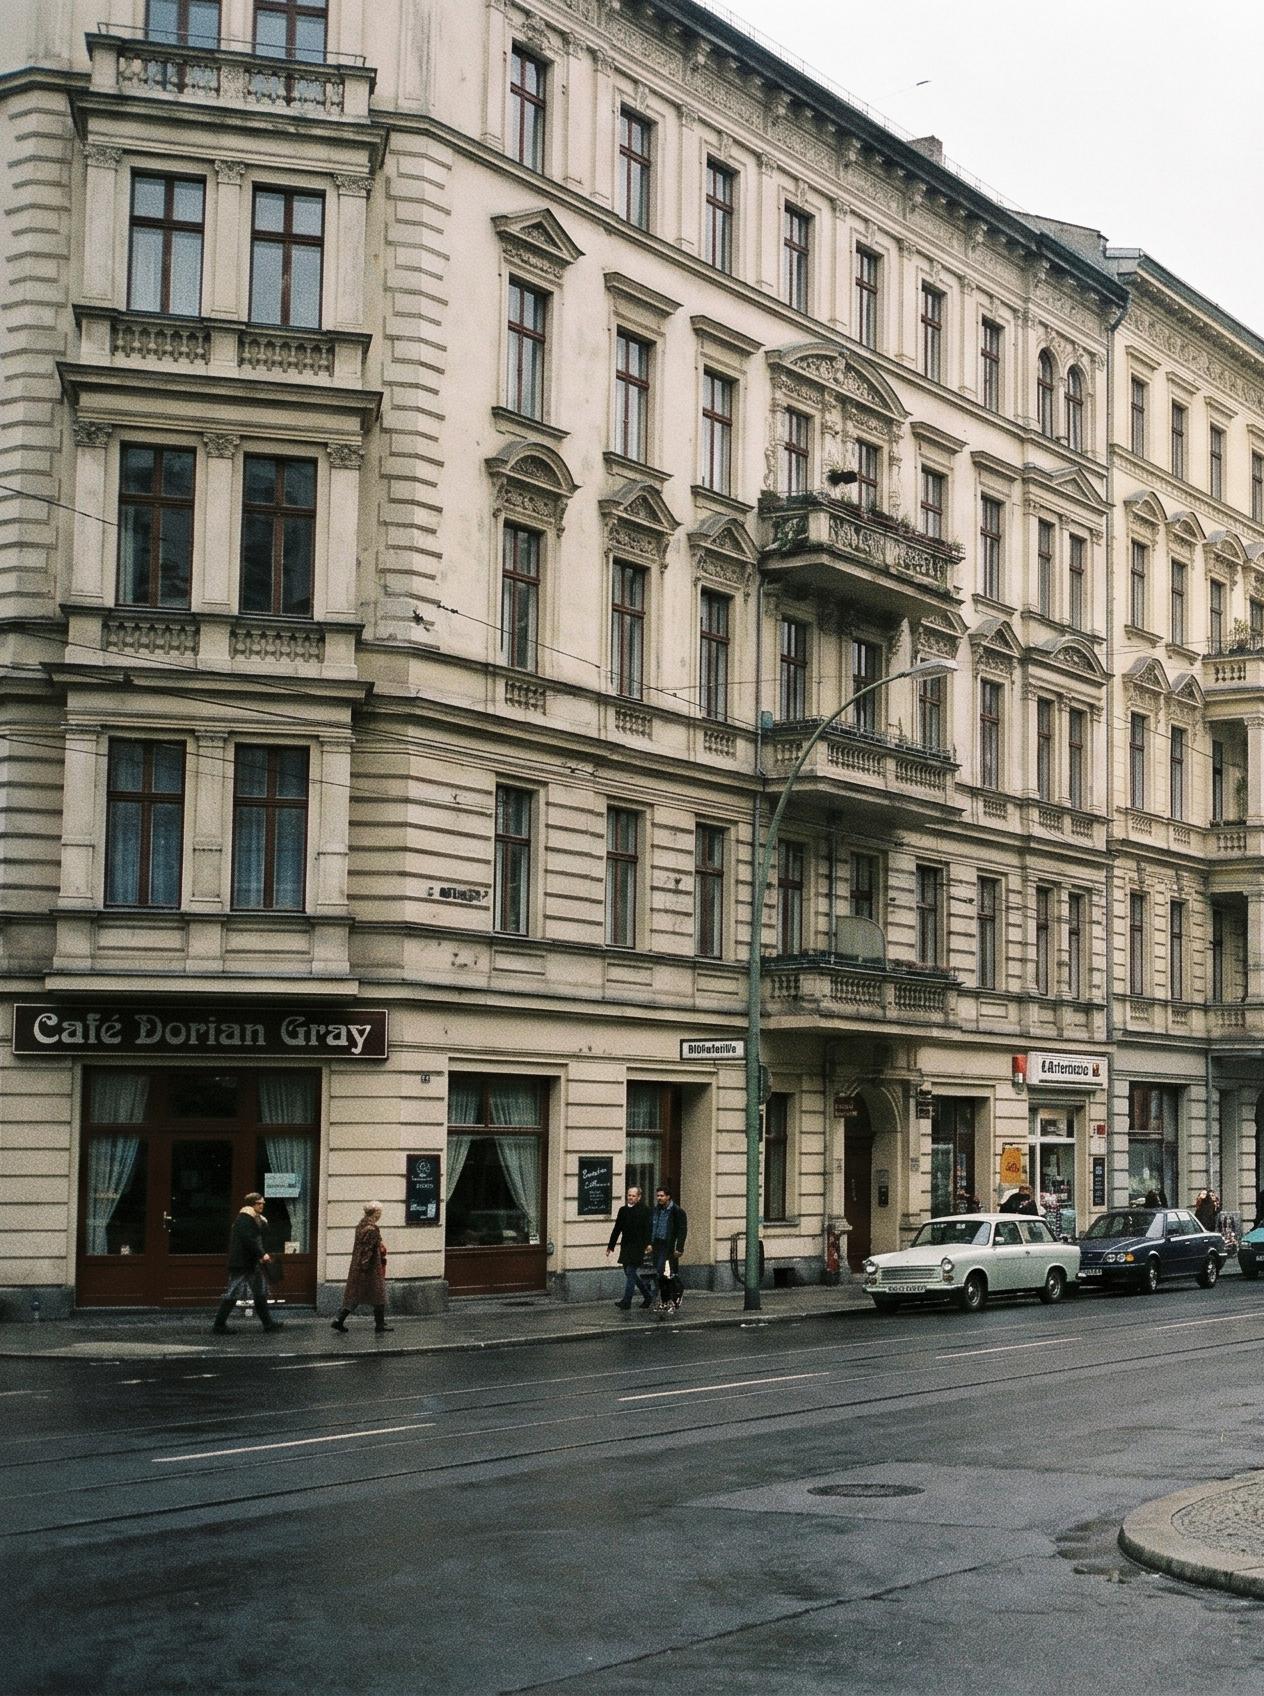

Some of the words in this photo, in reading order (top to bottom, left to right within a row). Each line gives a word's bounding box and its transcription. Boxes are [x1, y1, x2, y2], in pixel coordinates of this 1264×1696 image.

[33, 1013, 122, 1045] Café
[135, 1015, 266, 1046] Dorian
[280, 1016, 372, 1054] Gray
